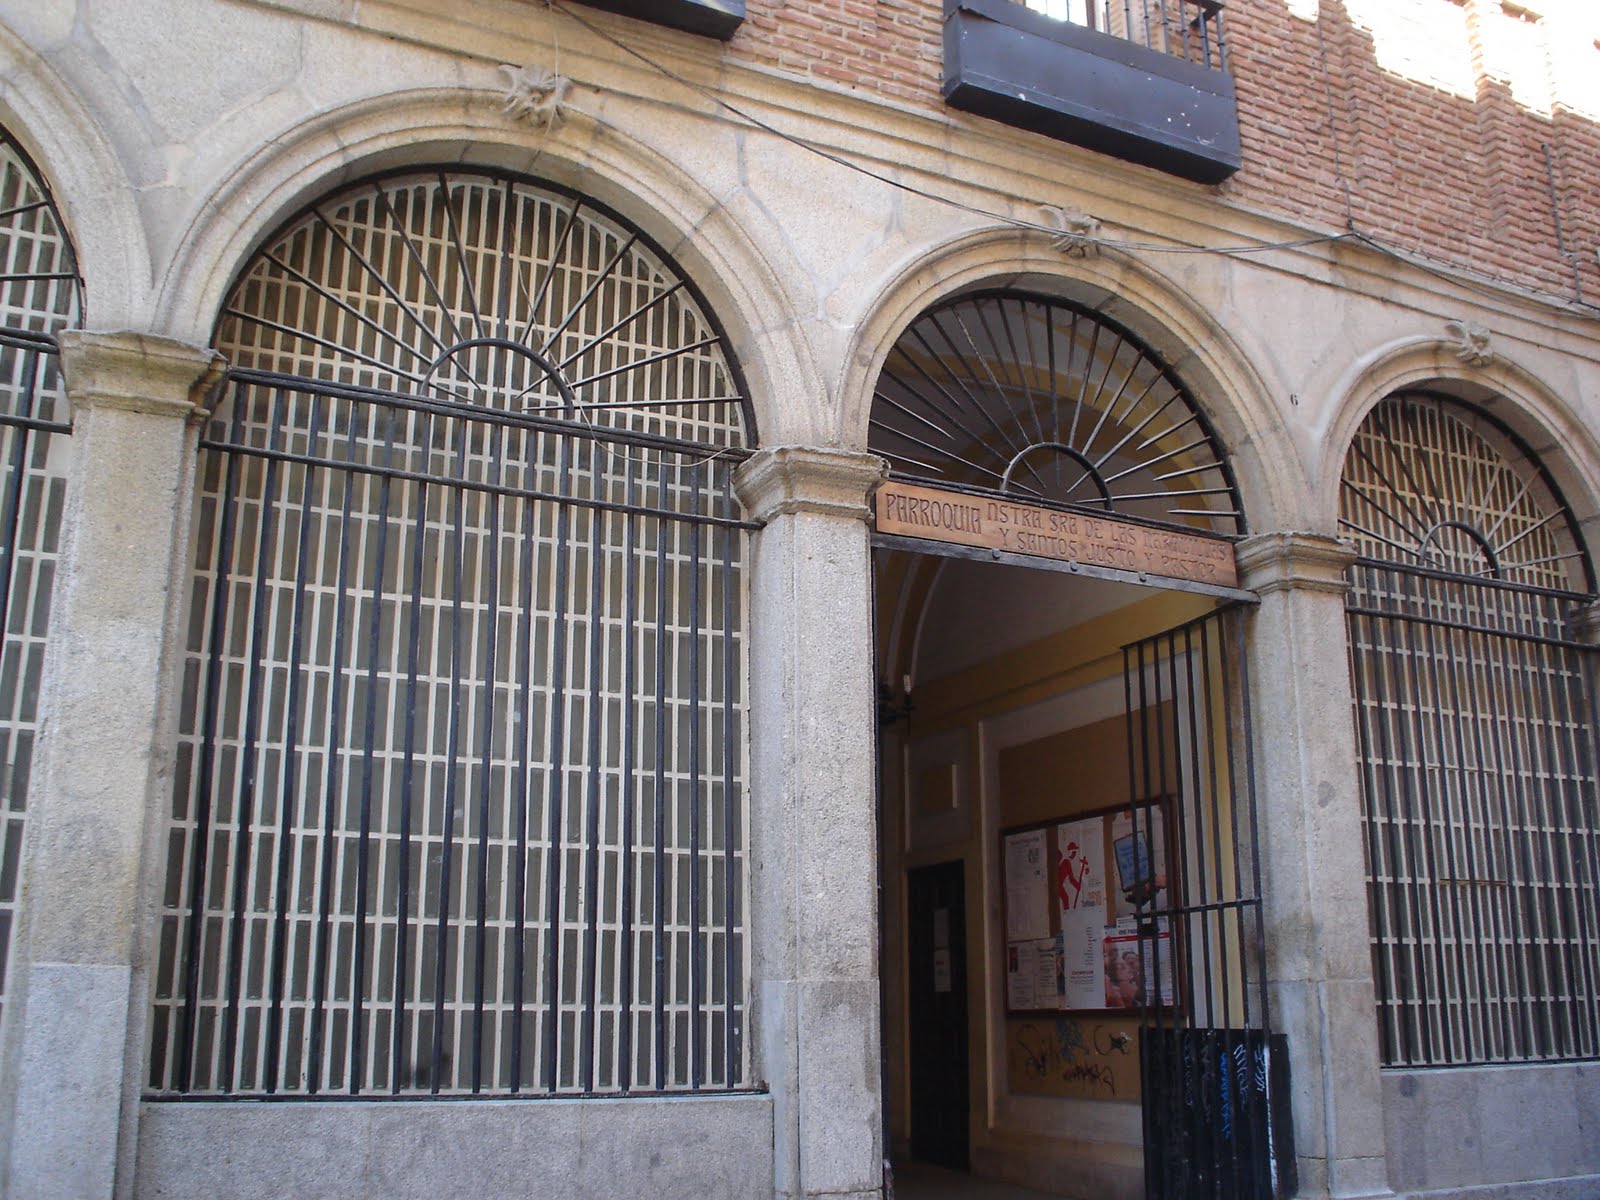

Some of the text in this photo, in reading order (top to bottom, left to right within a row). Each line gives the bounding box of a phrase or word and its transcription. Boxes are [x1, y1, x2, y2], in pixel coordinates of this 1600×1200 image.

[1290, 394, 1298, 405] 6
[886, 493, 982, 534] PARROQUIA
[1084, 519, 1104, 540] DE
[1110, 523, 1137, 546] LAS
[999, 527, 1218, 580] Y SANTOS JUSTO Y PASTOR
